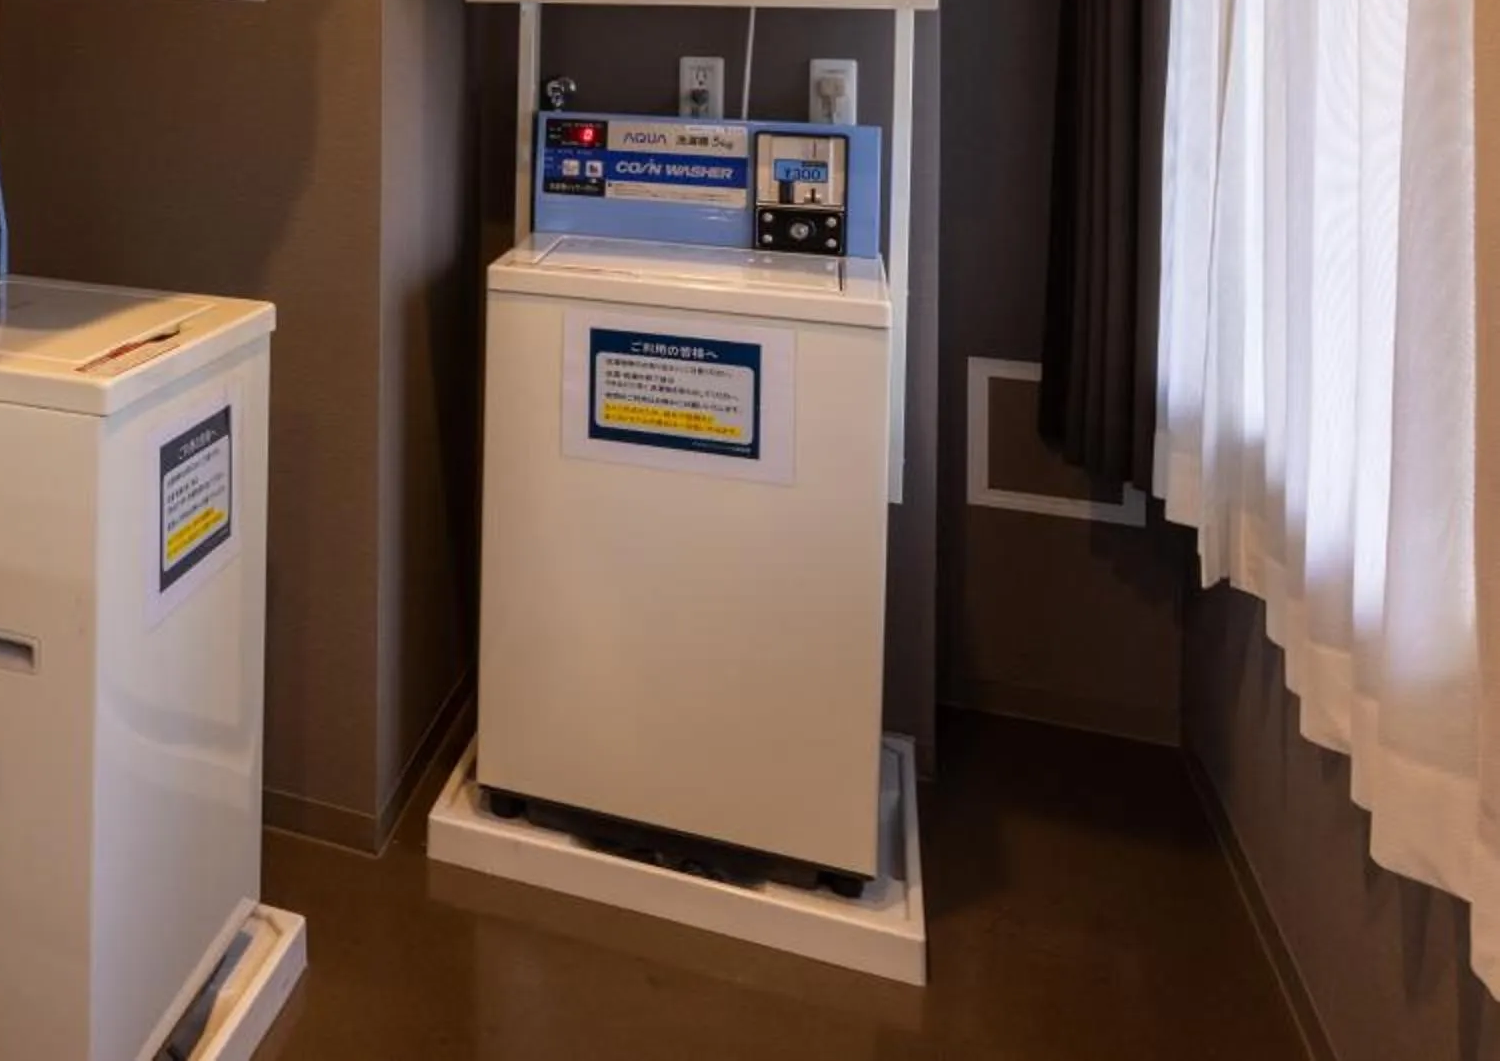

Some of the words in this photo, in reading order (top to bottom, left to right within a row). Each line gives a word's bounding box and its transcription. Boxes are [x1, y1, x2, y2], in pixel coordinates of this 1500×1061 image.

[623, 133, 666, 144] AQUA
[615, 158, 663, 175] COIN
[666, 164, 733, 179] WASHER
